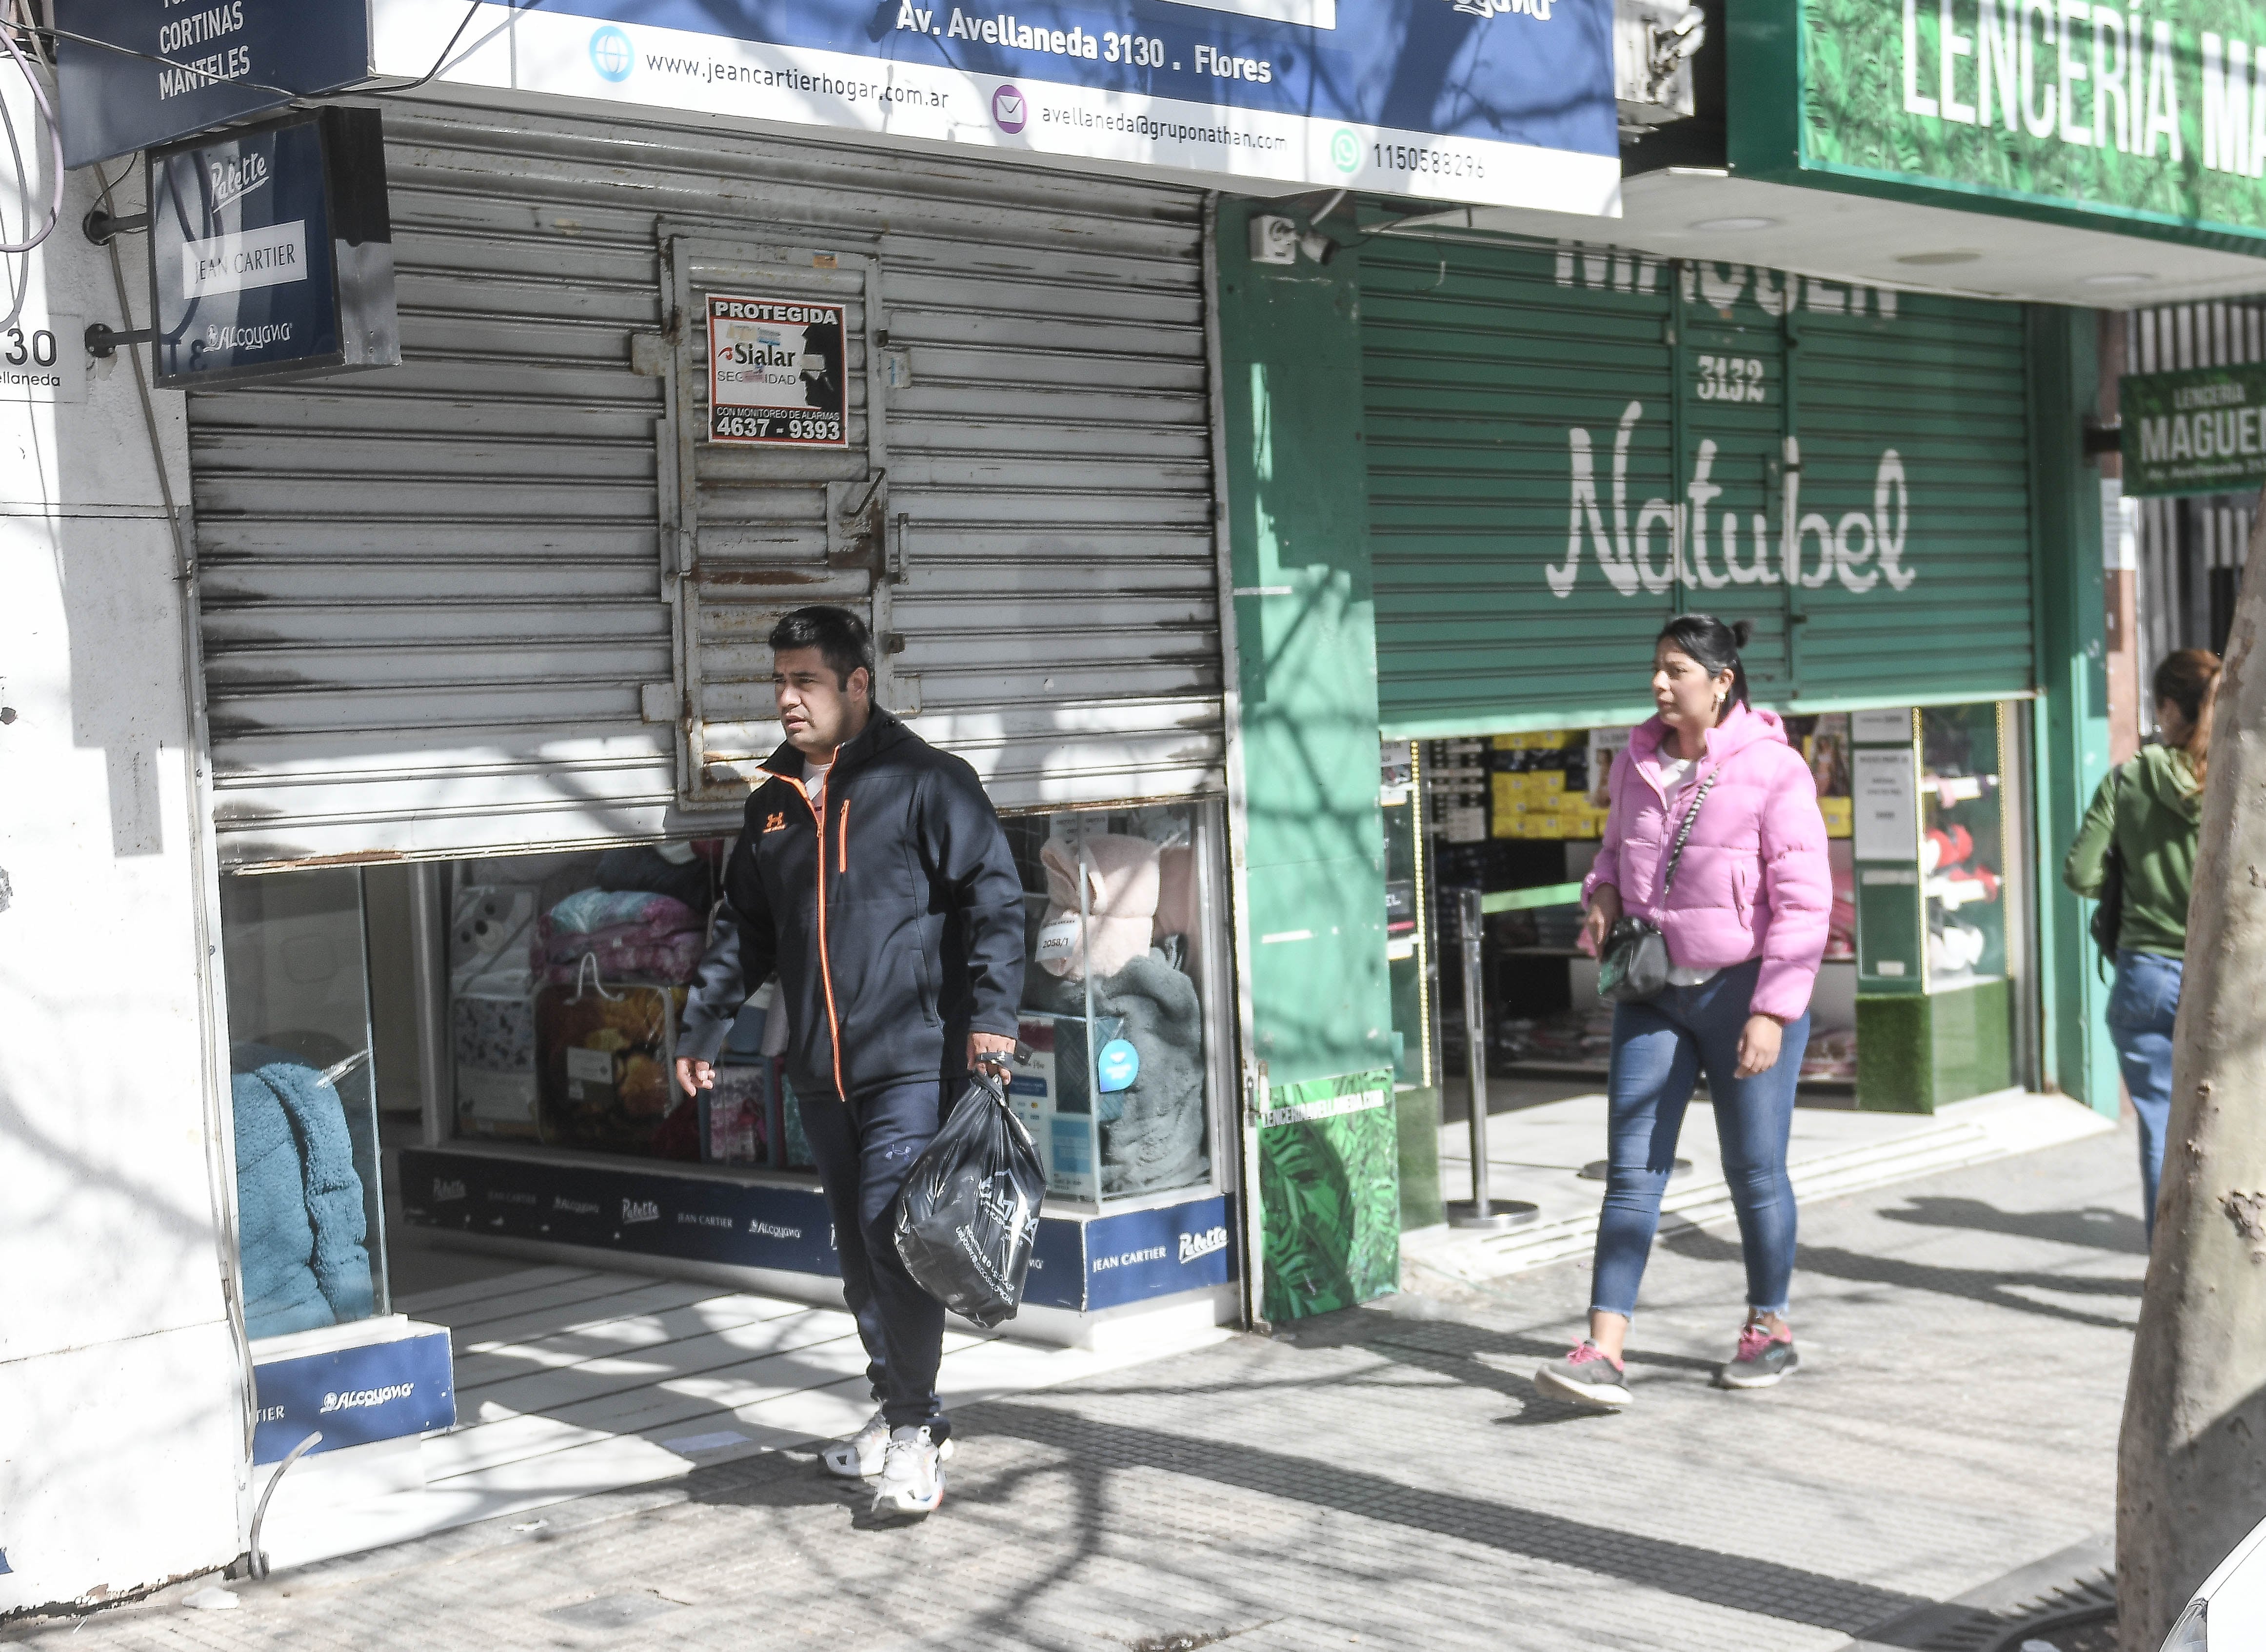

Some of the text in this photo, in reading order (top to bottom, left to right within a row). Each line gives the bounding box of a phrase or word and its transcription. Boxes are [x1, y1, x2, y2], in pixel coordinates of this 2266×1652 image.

[159, 0, 244, 54] CORTINAS
[896, 0, 941, 37] Av.
[948, 7, 1098, 60] Avellaneda
[1104, 32, 1165, 68] 3130
[1194, 44, 1272, 84] Flores
[159, 45, 250, 100] MANTELES
[646, 54, 949, 108] www.jeancartierhogar.com.ar
[1904, 0, 2182, 161] LENCERÍA
[1043, 105, 1288, 151] avellaneda@gruponathan.com
[211, 153, 269, 211] Palette
[1373, 142, 1486, 178] 1150588296
[195, 243, 296, 284] JEAN CARTIER
[715, 301, 838, 325] PROTEGIDA
[717, 370, 796, 386] SEGIDAD
[734, 341, 796, 367] Sialar
[0, 371, 60, 386] llaneda
[1697, 354, 1766, 403] 3132
[716, 417, 770, 437] 4637
[789, 420, 840, 440] 9393
[717, 407, 840, 421] CON MONITOREO DE ALARMAS
[2140, 406, 2266, 461] MAGUE
[1545, 400, 1916, 598] Natubel
[1092, 1226, 1228, 1274] JEAN CARTIER Palette
